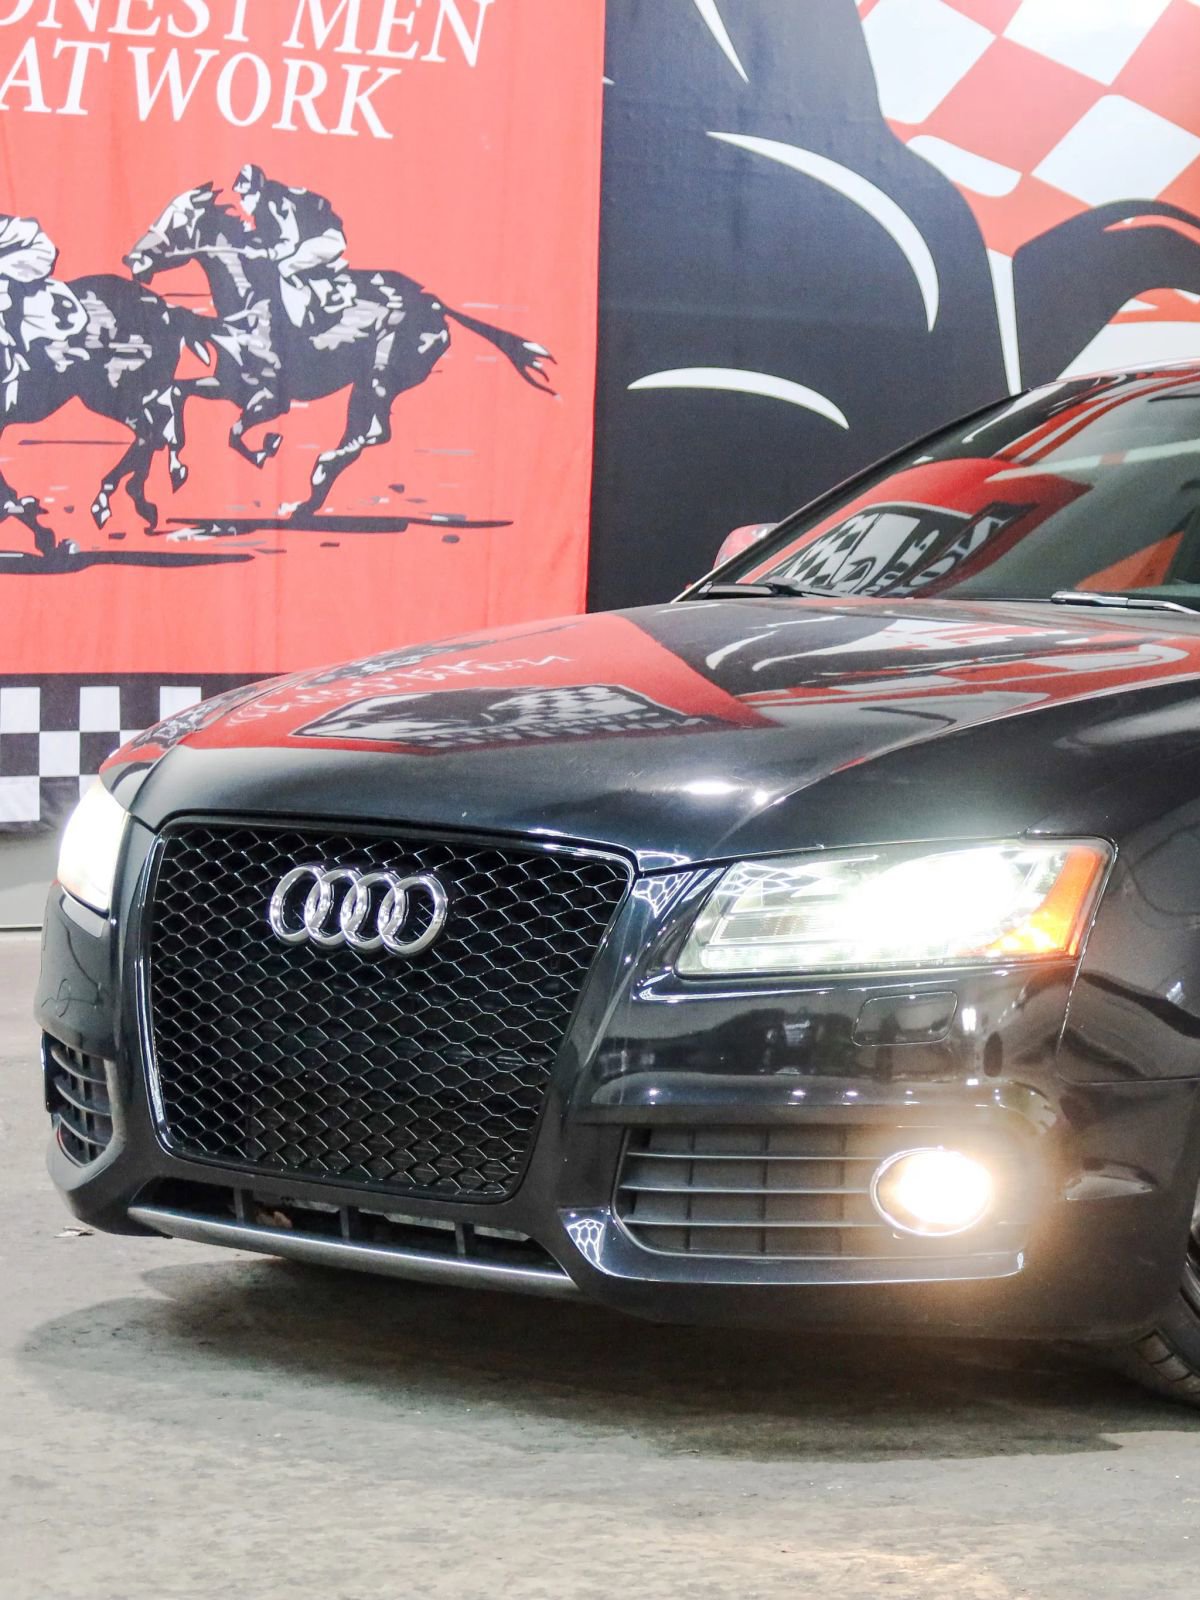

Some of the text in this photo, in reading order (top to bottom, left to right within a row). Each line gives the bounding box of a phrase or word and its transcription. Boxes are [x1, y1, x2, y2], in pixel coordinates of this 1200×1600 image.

[0, 0, 495, 68] NEST MEN
[0, 37, 402, 139] AT WORK
